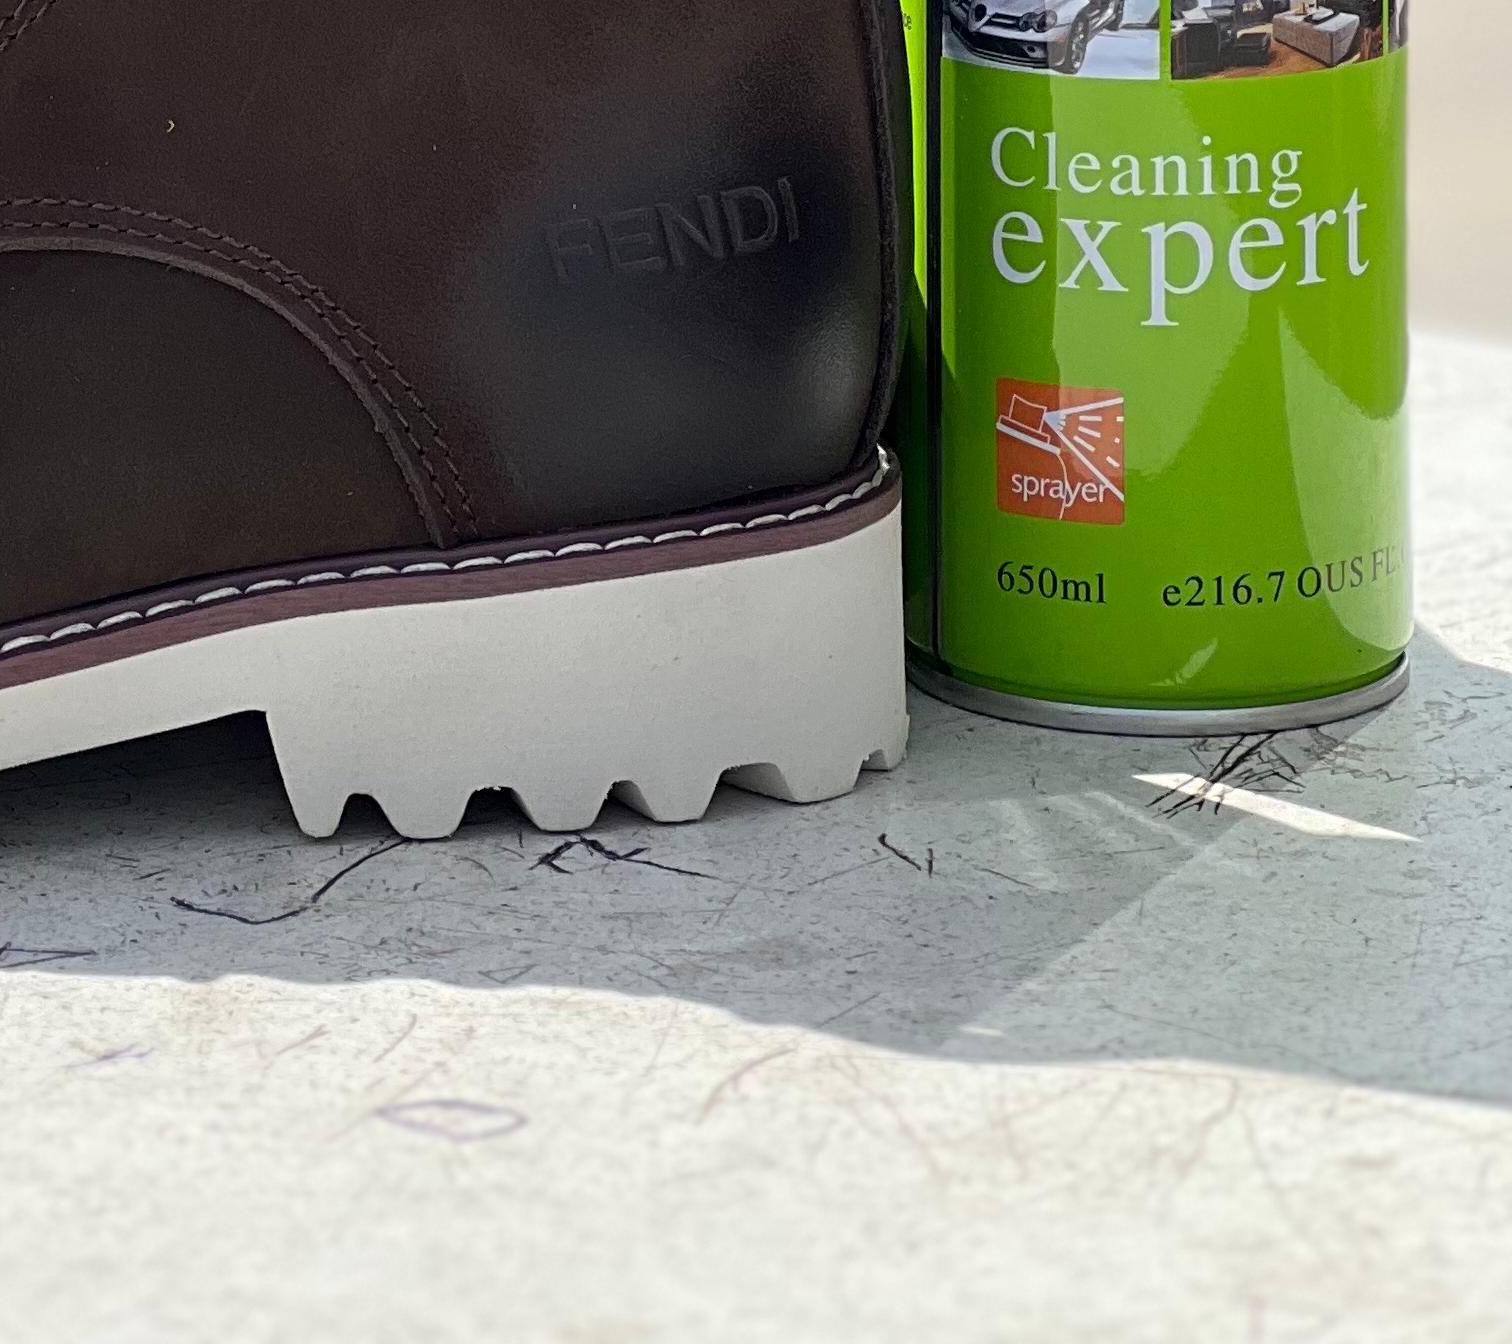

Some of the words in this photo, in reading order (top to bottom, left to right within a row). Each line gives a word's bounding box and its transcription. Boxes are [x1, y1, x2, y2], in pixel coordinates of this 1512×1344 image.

[990, 126, 1303, 209] Cleaning
[544, 176, 800, 279] FENDI
[991, 186, 1370, 327] expert
[1011, 473, 1109, 508] sprayer
[997, 561, 1108, 604] 650ml
[1162, 570, 1286, 607] e216.7
[1296, 555, 1364, 598] OUS
